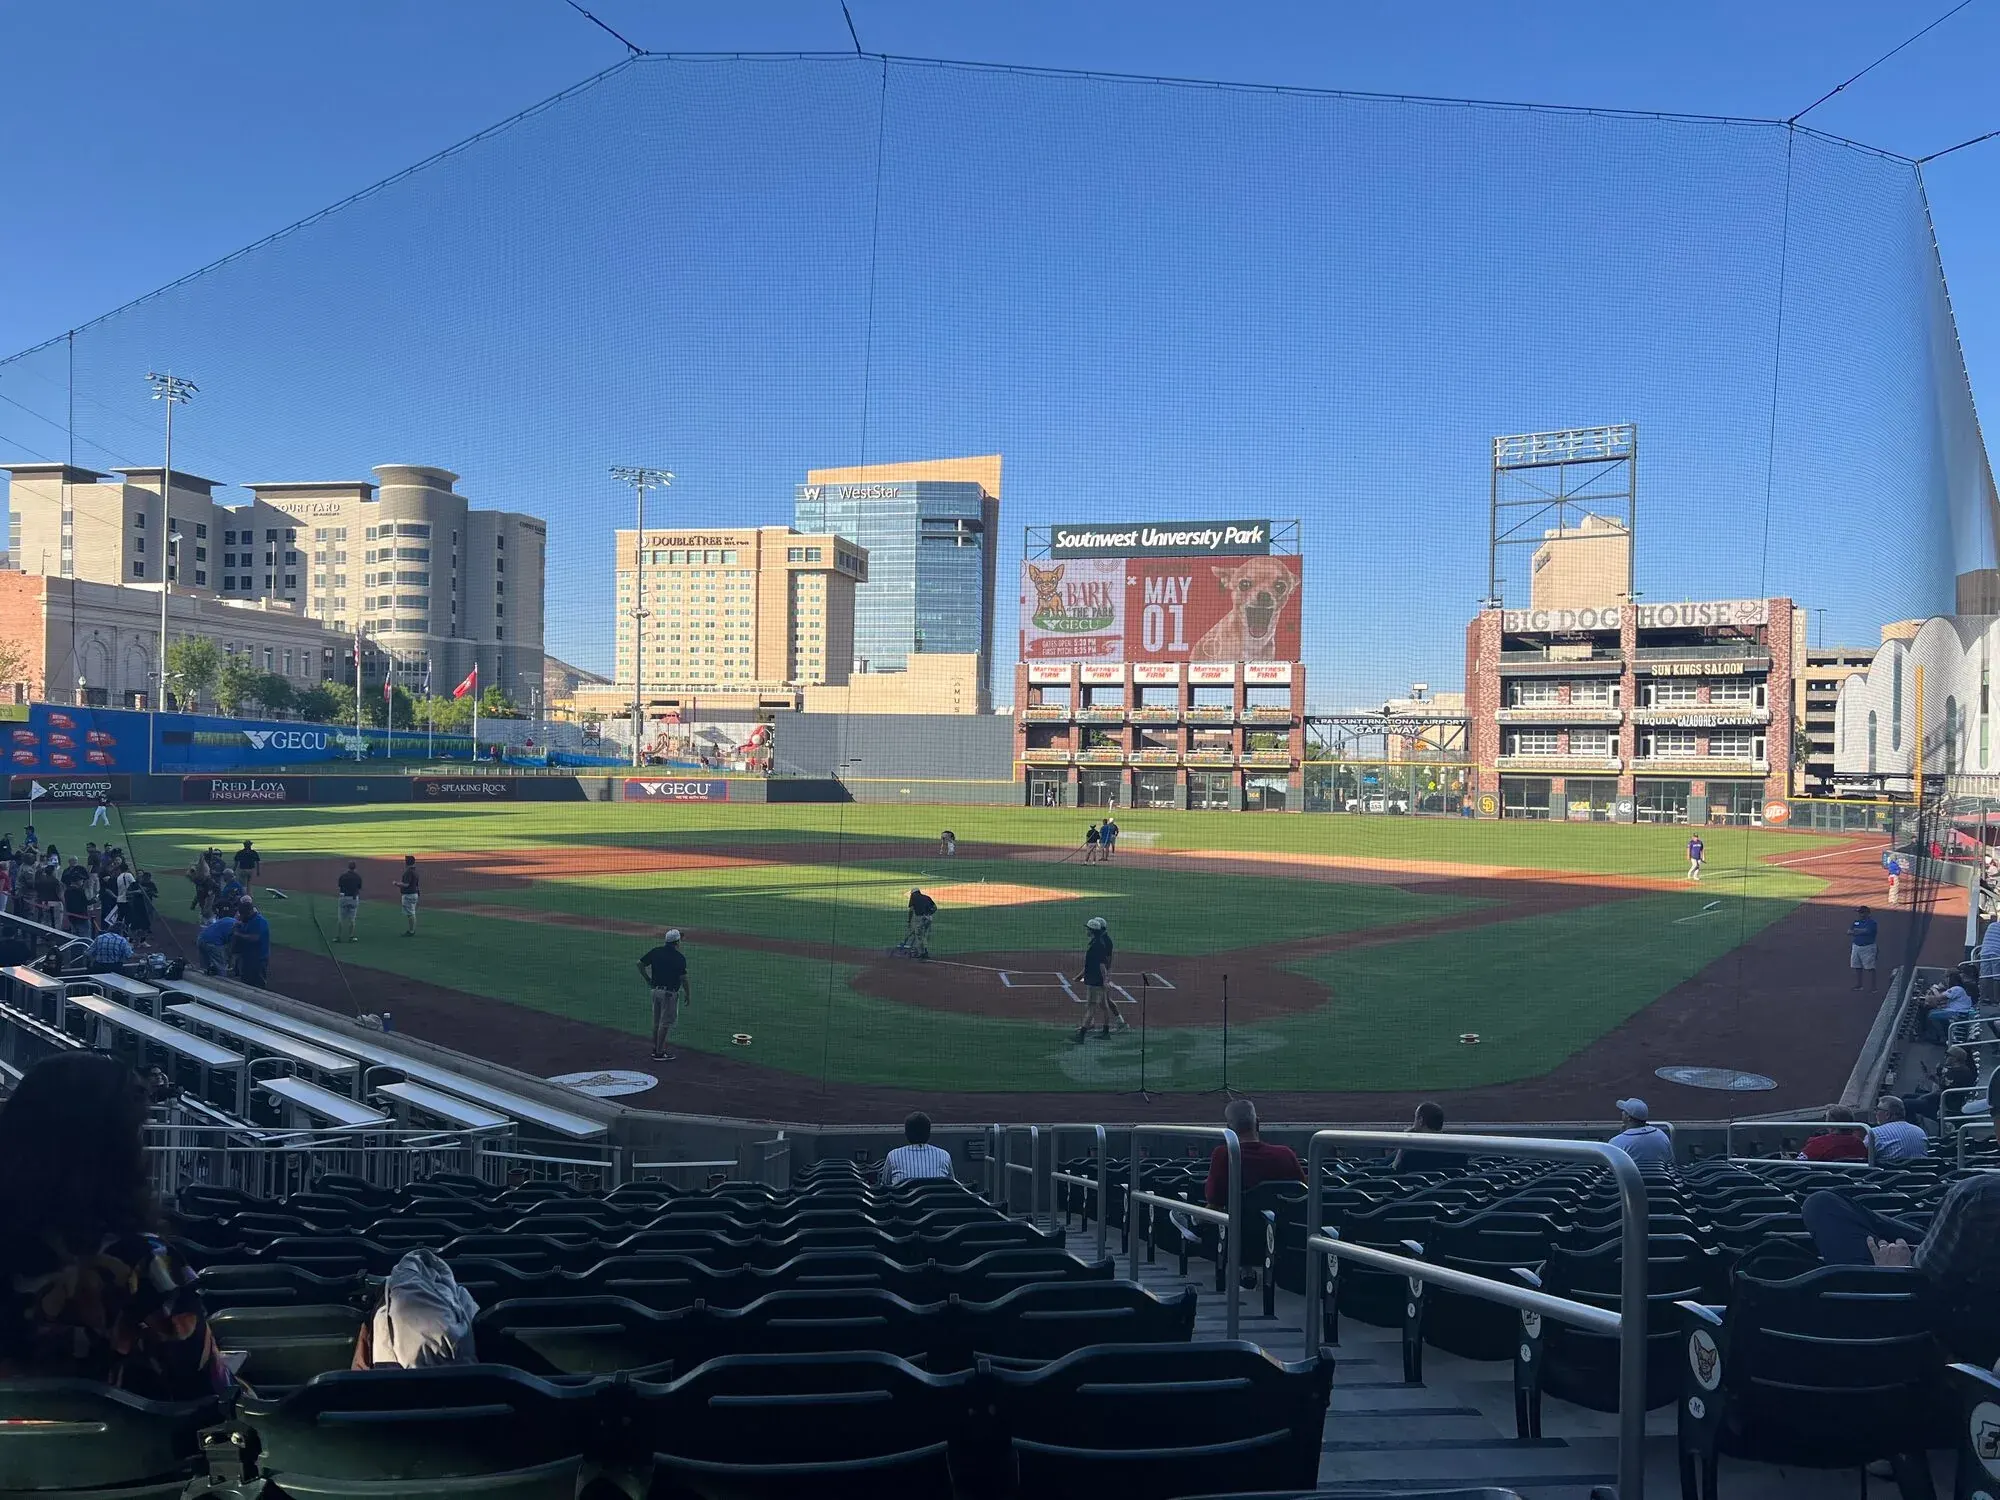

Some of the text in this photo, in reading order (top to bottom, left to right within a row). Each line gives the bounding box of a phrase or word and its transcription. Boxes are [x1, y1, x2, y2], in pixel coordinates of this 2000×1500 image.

[839, 485, 899, 500] WestStar
[273, 503, 340, 512] COURTYARD
[1055, 525, 1264, 549] Southwest University Park
[1066, 581, 1114, 609] BARK
[1144, 577, 1192, 604] MAY
[1072, 607, 1089, 617] THE
[1092, 606, 1114, 617] PARK
[1505, 603, 1731, 632] BIG DOG HOUSE
[1059, 619, 1099, 629] GECU
[1142, 604, 1189, 652] 01
[1088, 638, 1097, 646] PM
[1088, 646, 1097, 654] PM
[1651, 662, 1744, 676] SUN KINGS SALOON
[1639, 714, 1759, 727] TEQUILA CAZADORES CANTINA
[1355, 726, 1417, 734] GATEWAY
[271, 731, 327, 750] GECU
[61, 782, 112, 790] AUTOMATED
[212, 779, 285, 791] FRED LOYA
[441, 782, 507, 795] SPEAKING ROCK
[661, 782, 709, 795] GECU
[211, 791, 285, 800] INSURANCE
[1618, 802, 1631, 812] 42
